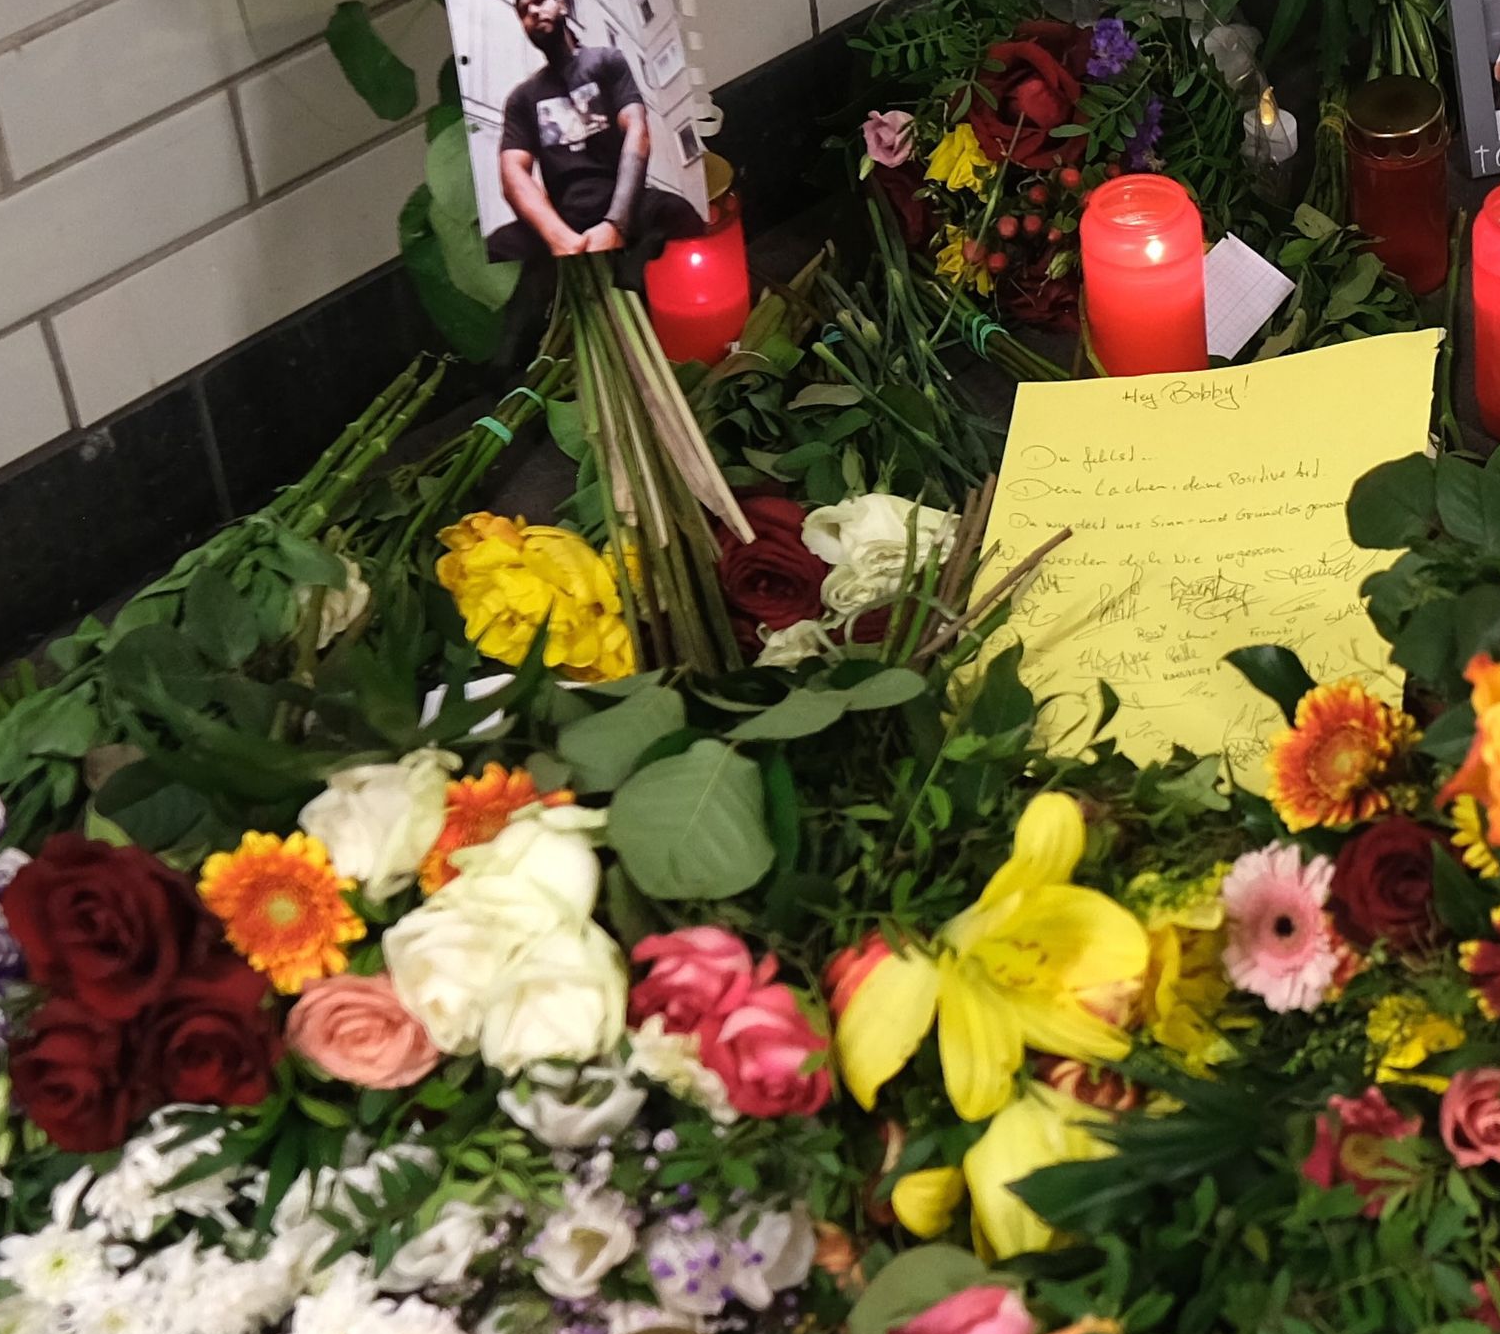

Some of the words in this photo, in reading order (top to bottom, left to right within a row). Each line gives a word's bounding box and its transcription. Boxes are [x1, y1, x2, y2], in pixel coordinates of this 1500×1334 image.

[1122, 388, 1158, 409] Hey
[1021, 444, 1070, 470] Du
[1006, 478, 1082, 501] Dein
[1008, 512, 1037, 529] Du
[1115, 521, 1141, 530] uns
